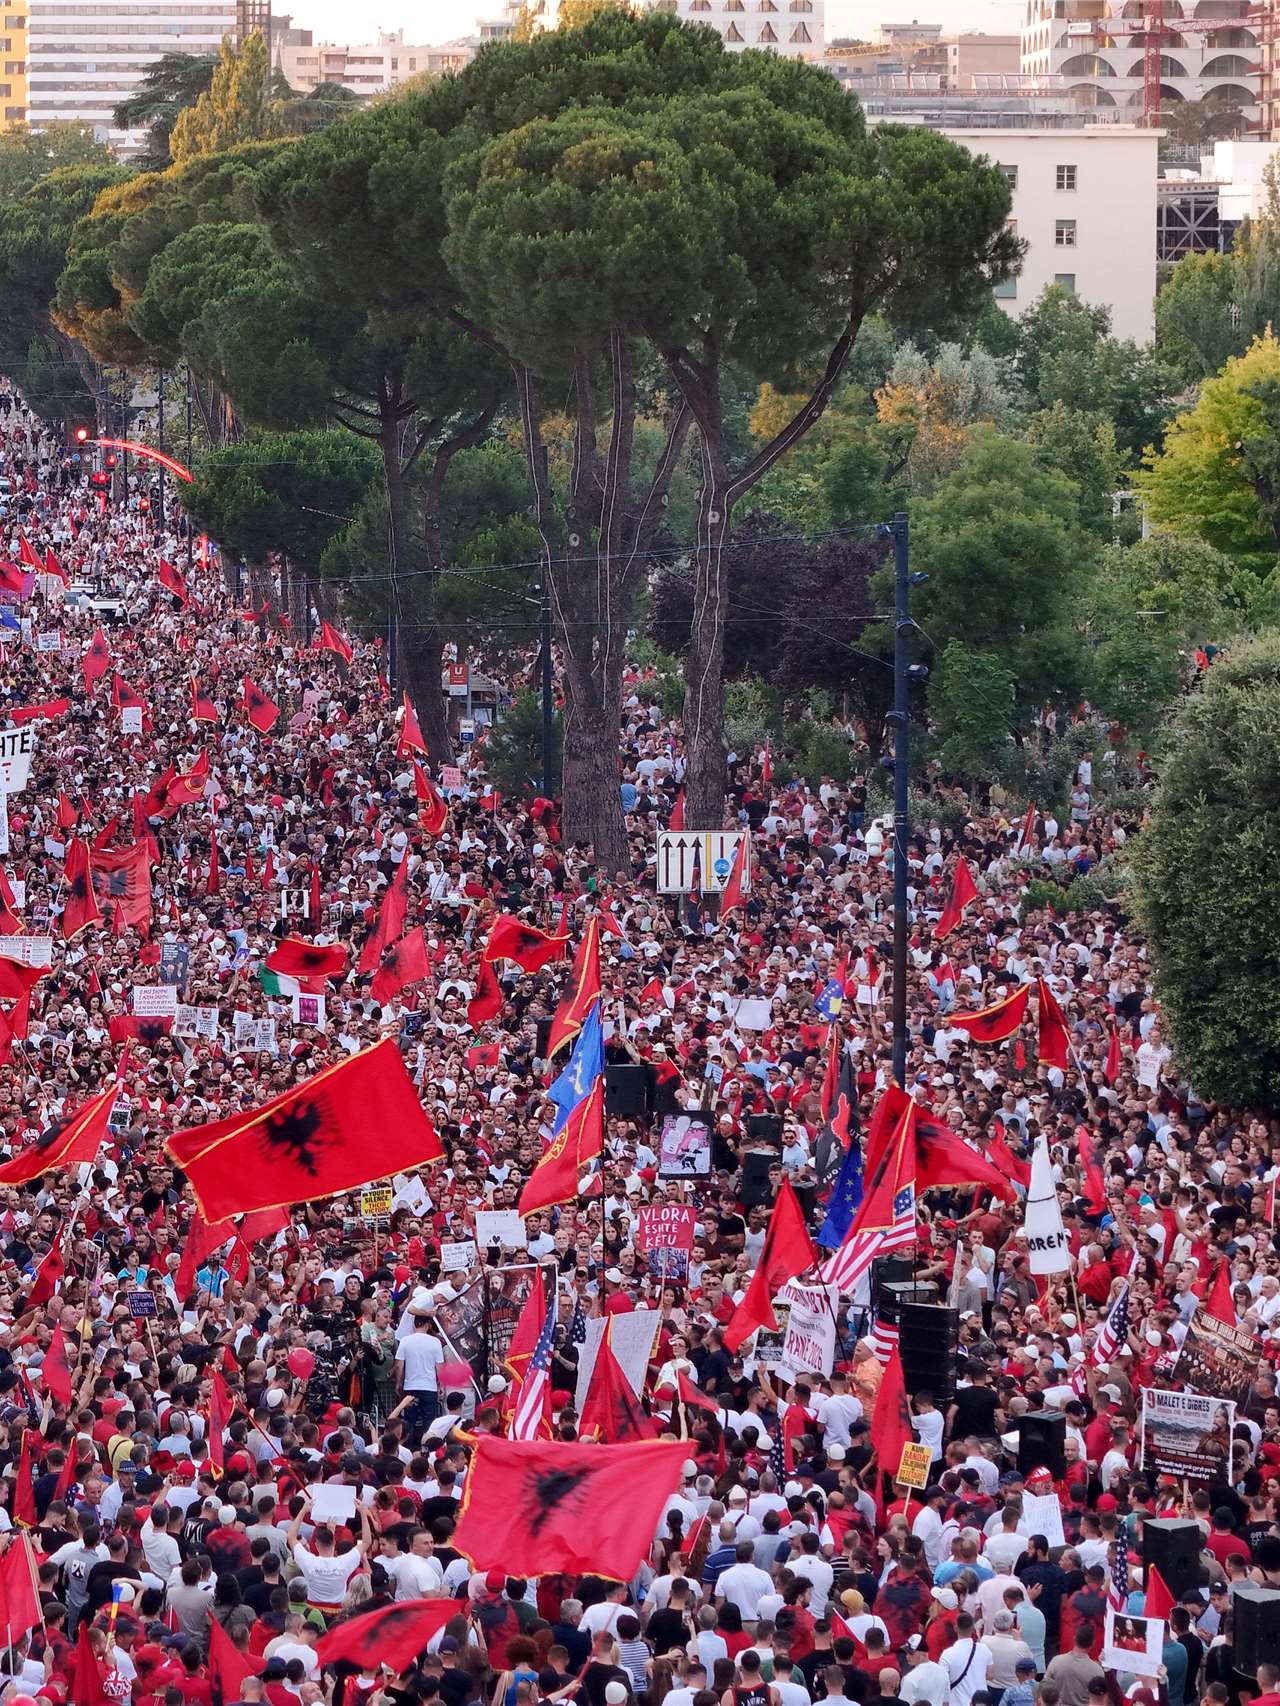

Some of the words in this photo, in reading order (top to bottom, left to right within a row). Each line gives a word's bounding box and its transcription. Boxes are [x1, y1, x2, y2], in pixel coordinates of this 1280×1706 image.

[642, 1208, 690, 1223] VLORA
[1147, 1390, 1156, 1409] 9
[1157, 1394, 1180, 1410] MALET
[1182, 1399, 1186, 1409] E
